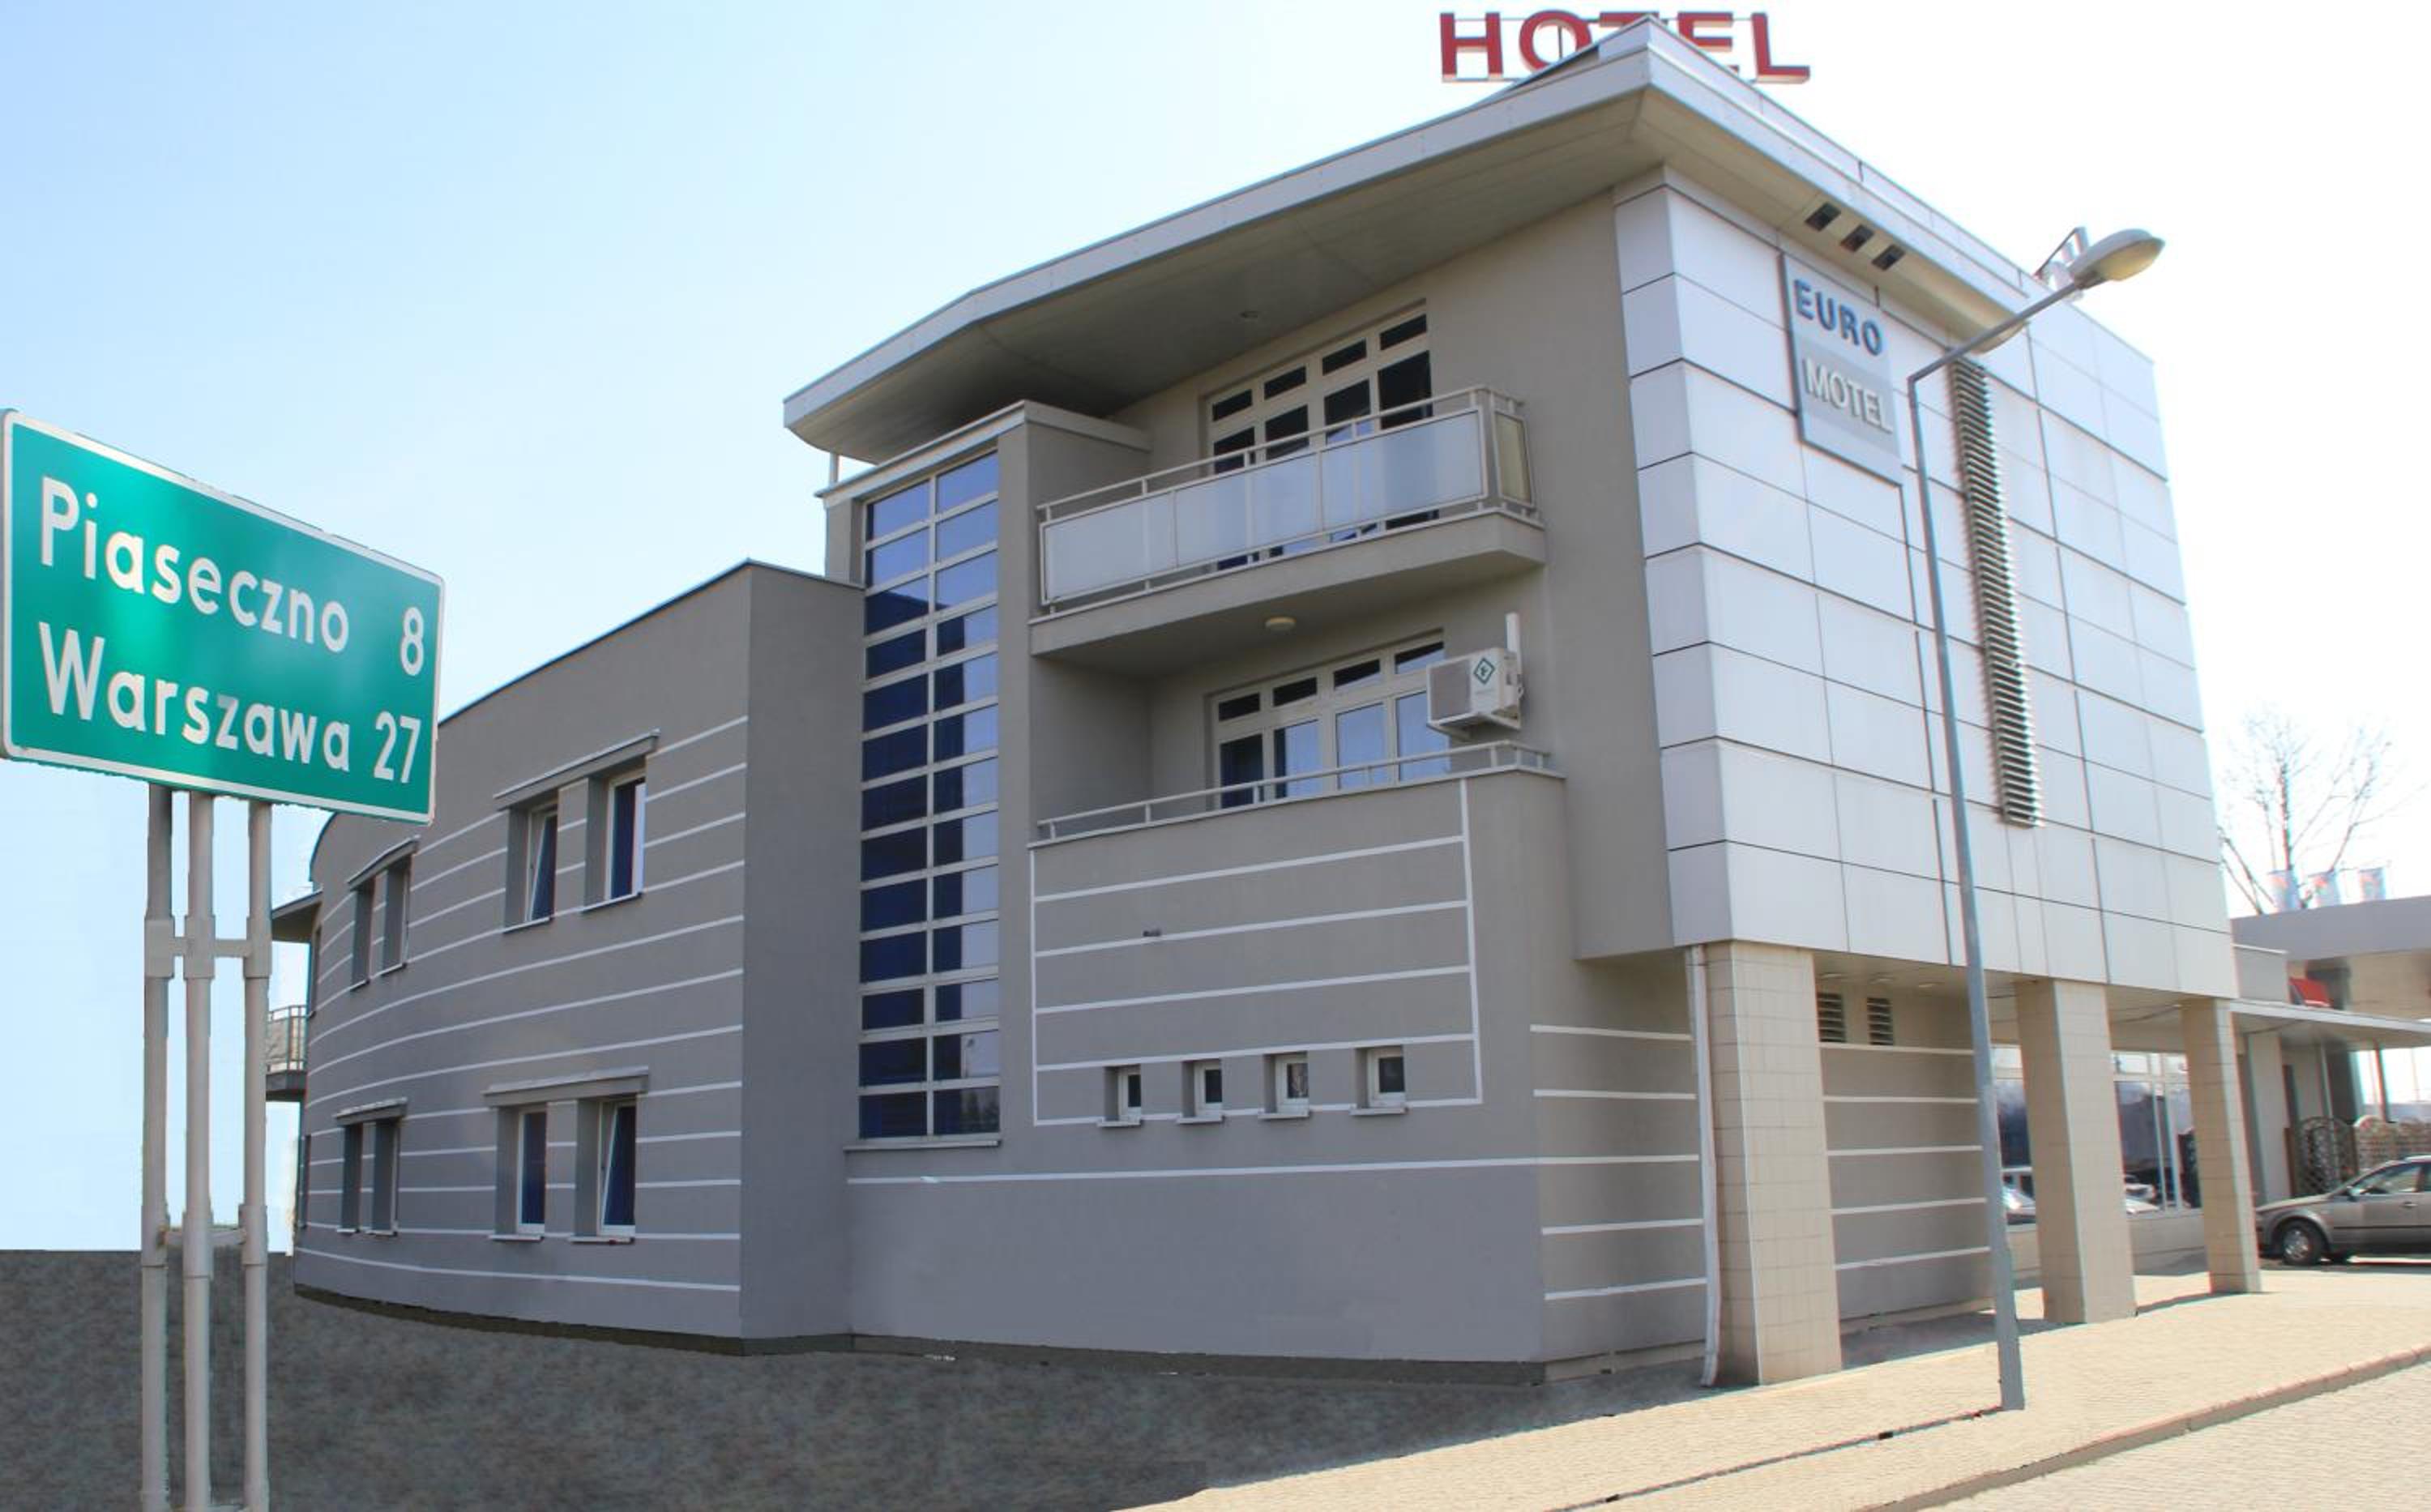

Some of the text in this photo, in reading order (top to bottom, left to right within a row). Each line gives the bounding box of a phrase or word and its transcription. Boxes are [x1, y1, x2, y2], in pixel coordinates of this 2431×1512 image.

[1793, 279, 1882, 357] EURO
[1801, 358, 1893, 434] MOTEL
[40, 476, 424, 676] Piaseczno 8
[39, 621, 421, 784] Warszawa 27
